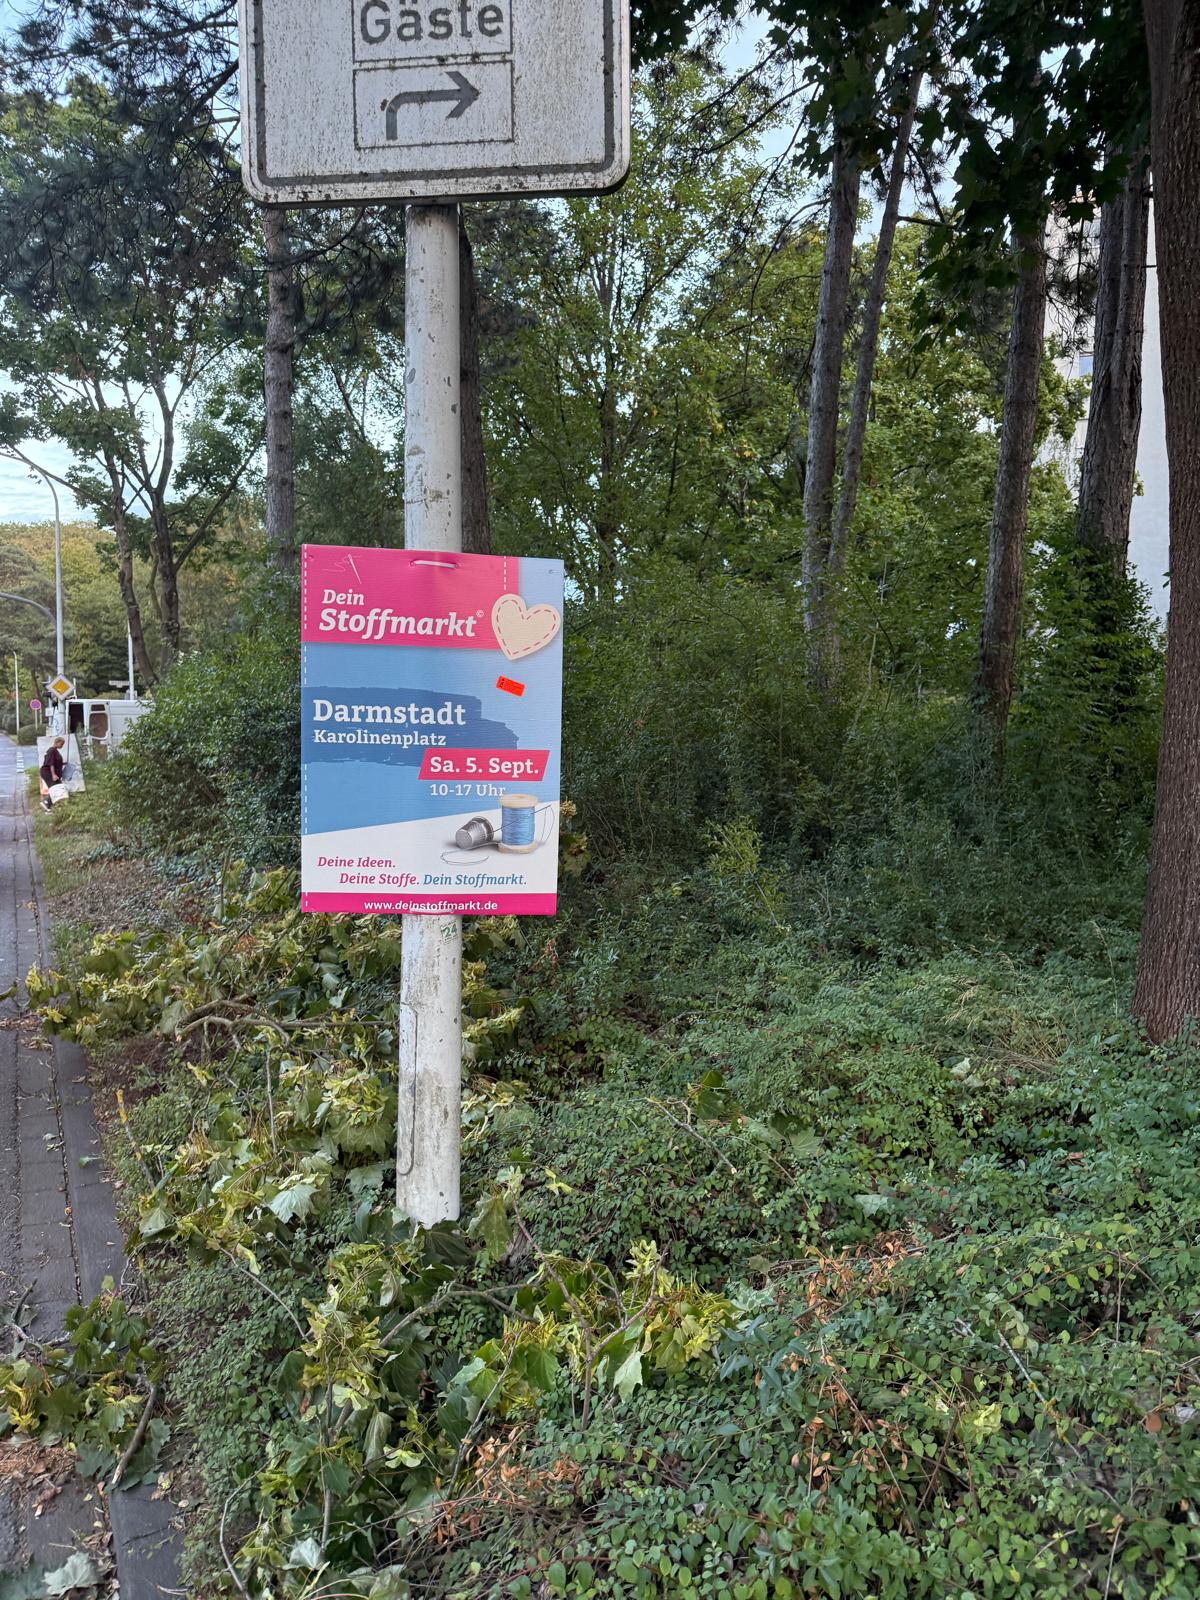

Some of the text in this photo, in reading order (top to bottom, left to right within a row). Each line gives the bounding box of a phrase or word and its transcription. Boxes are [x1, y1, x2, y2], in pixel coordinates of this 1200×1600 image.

[360, 0, 504, 44] Gäste
[321, 588, 365, 606] Dein
[313, 699, 466, 725] Darmstadt
[313, 729, 447, 748] Karolinenplatz
[430, 756, 539, 777] Sa. 5. Sept.
[430, 783, 506, 796] 10-17 Uhr
[317, 856, 396, 868] Deine Ideen.
[339, 873, 527, 888] Deine Stoffe. Dein Stoffmarkt.
[364, 900, 498, 911] www.deinstoffmarkt.de
